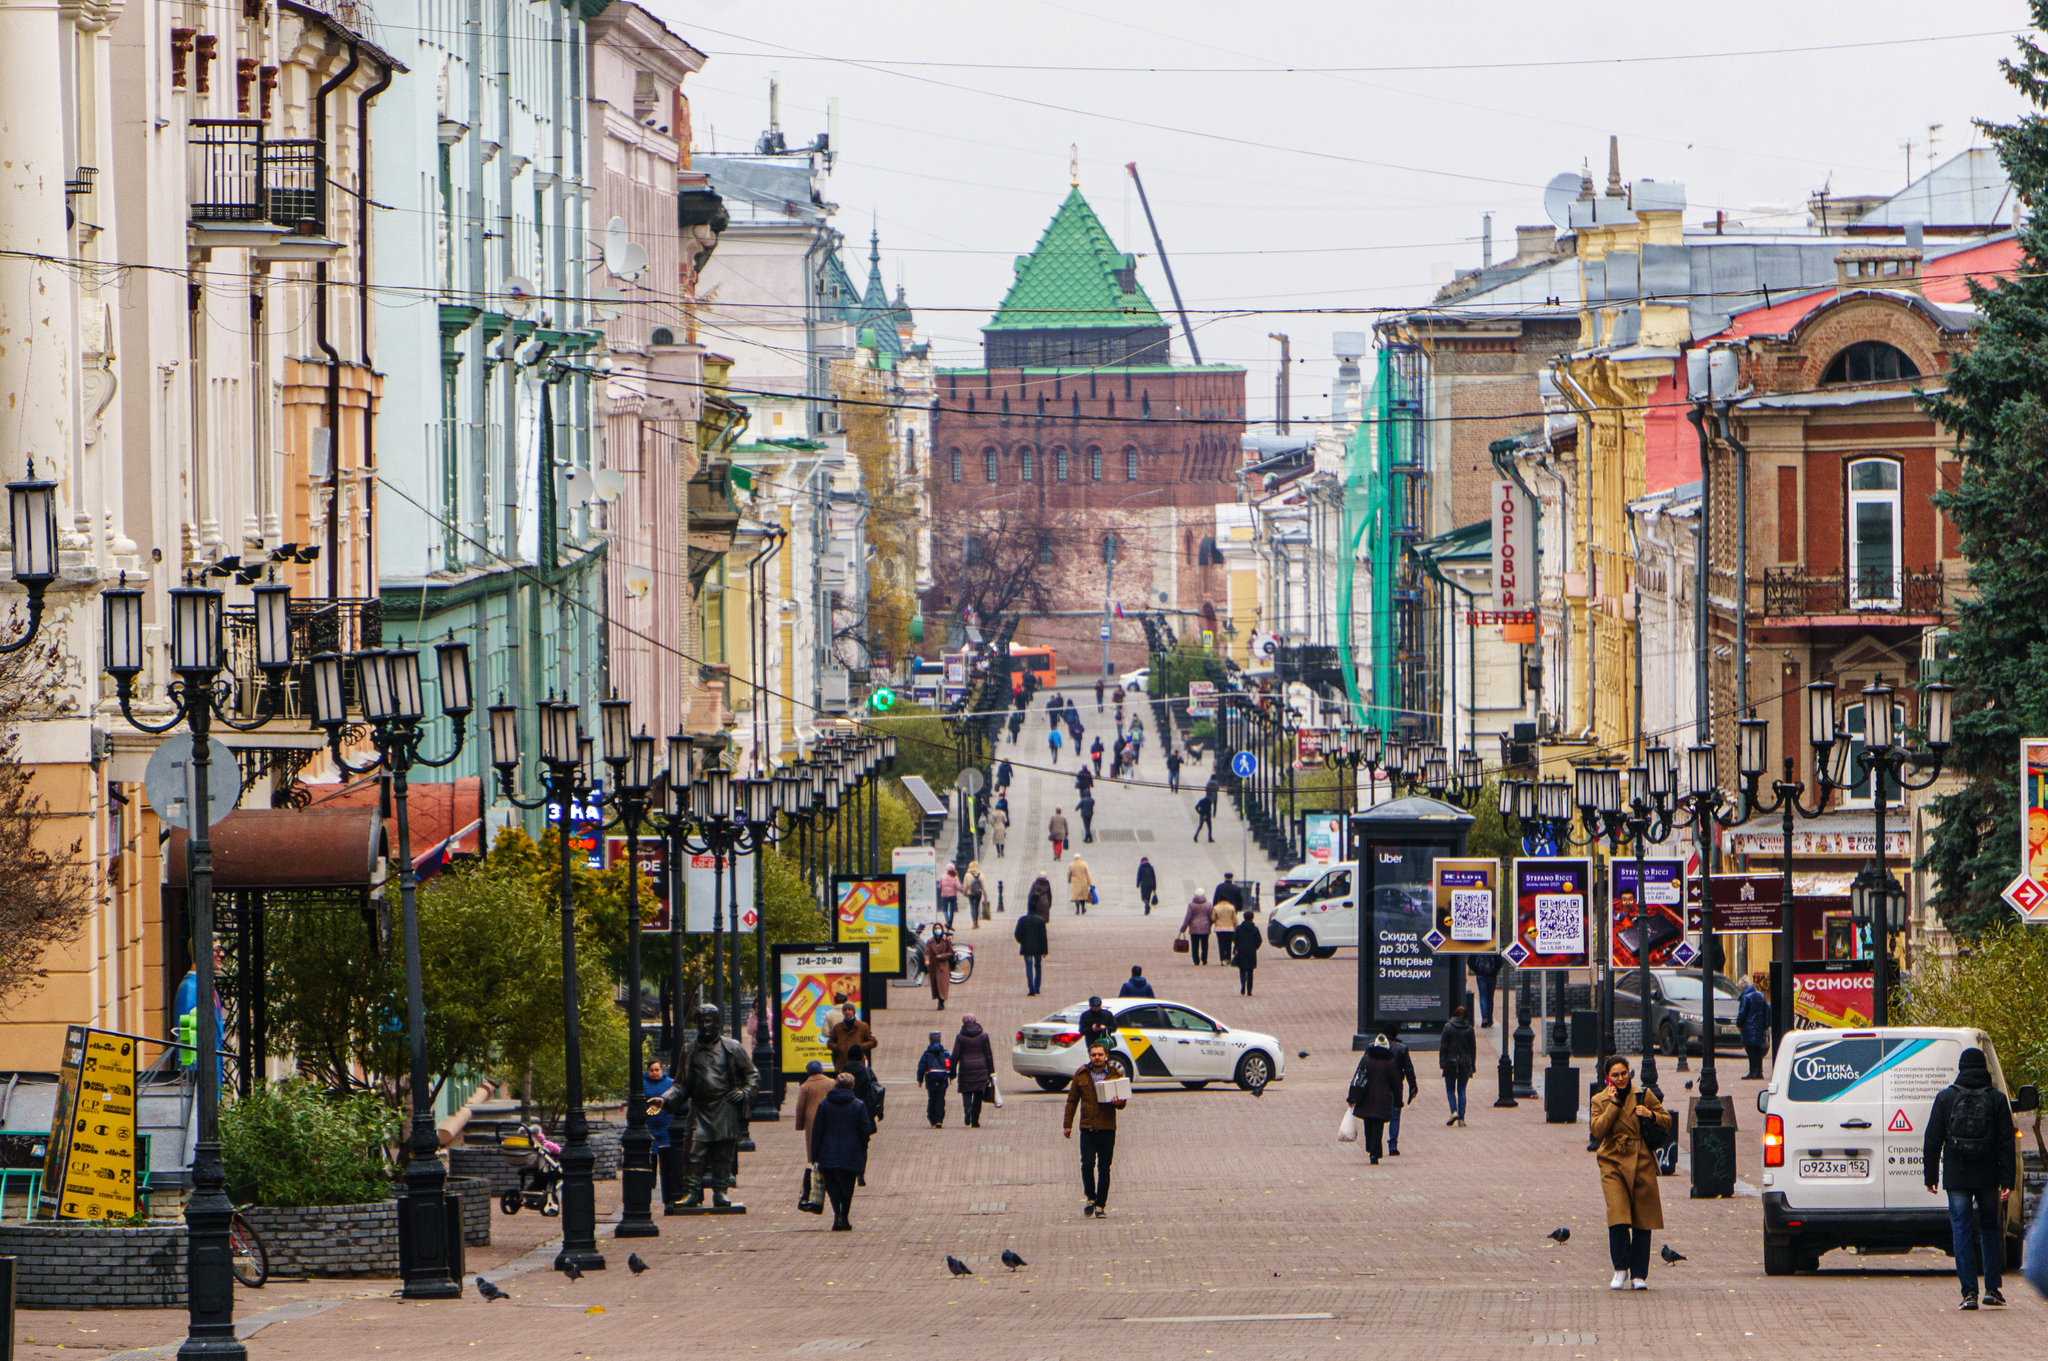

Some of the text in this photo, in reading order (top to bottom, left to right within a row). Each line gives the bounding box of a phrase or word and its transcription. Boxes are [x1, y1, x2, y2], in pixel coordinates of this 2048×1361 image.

[1500, 485, 1515, 607] ТОРГОВЫЙ
[1466, 611, 1536, 628] ЦЕНТР
[548, 803, 600, 820] ЗНА
[1379, 854, 1403, 864] Uber
[1379, 930, 1418, 943] Скидка
[1379, 946, 1394, 954] до
[797, 957, 843, 965] 214-20-80
[1379, 957, 1433, 968] на первые
[1379, 968, 1432, 980] 3 поездки
[1800, 991, 1815, 1000] ПРИЗ
[790, 1034, 815, 1043] Яндекс
[1896, 1120, 1905, 1128] Ш
[105, 1149, 131, 1158] ellesse
[1849, 1161, 1865, 1170] 152
